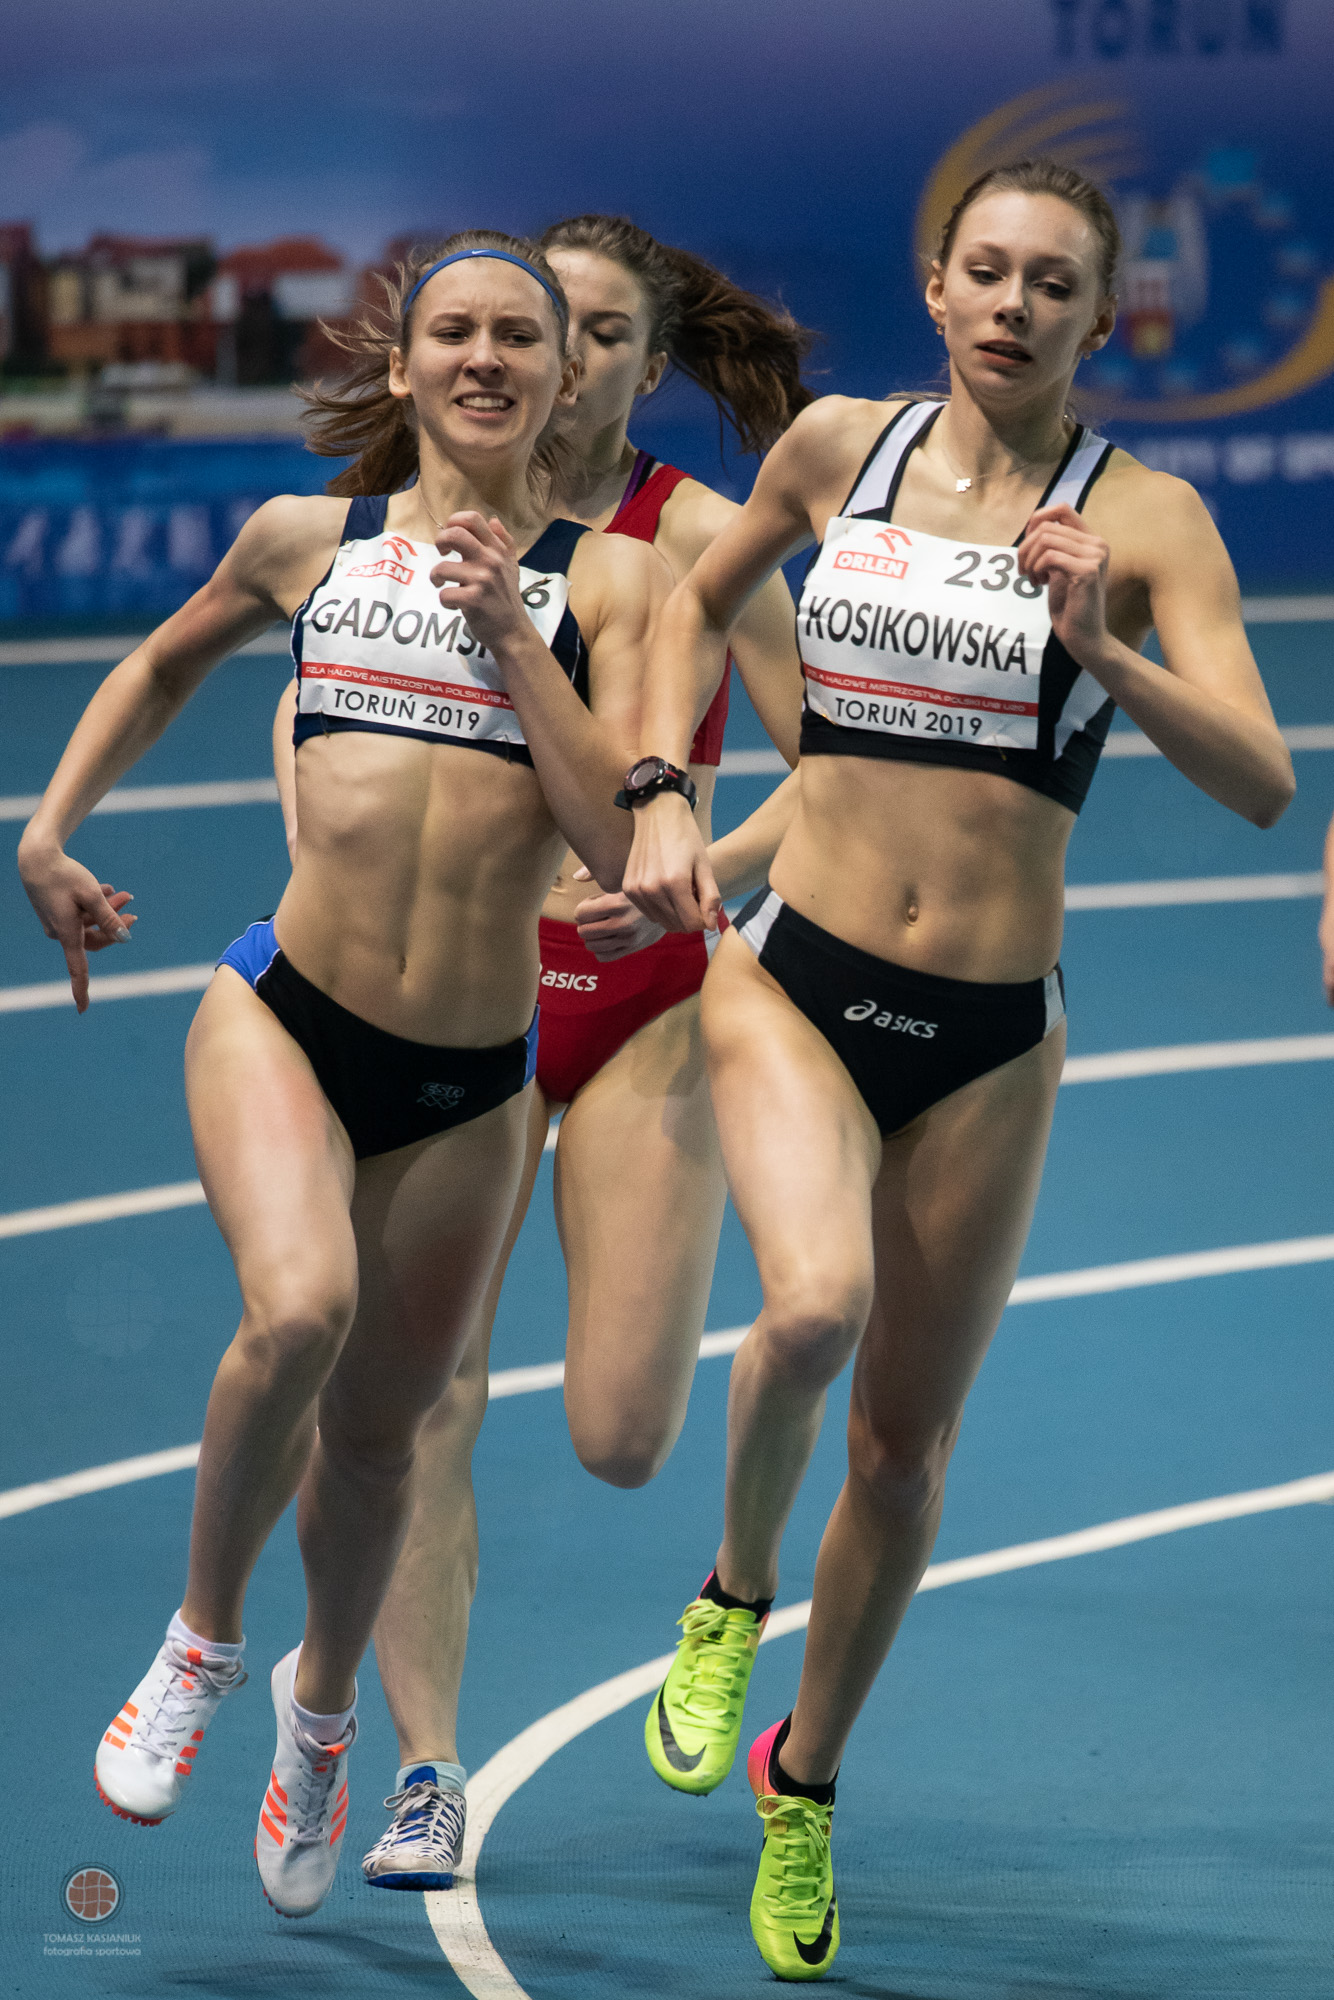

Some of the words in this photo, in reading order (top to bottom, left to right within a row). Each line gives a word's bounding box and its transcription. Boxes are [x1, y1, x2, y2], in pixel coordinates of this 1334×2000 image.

[350, 560, 411, 584] ORLEN
[836, 553, 906, 578] ORLEN
[805, 595, 1028, 675] KOSIKOWSKA
[305, 666, 326, 676] PZLA
[327, 668, 368, 681] HALOWE
[369, 674, 443, 694] MISTRZOSTWA
[446, 687, 480, 700] POLSKI
[826, 676, 867, 690] HALOWE
[869, 682, 942, 700] MISTRZOSTWA
[334, 688, 416, 721] TORUŃ
[422, 703, 481, 732] 2019
[835, 697, 916, 728] TORUŃ
[924, 711, 983, 736] 2019
